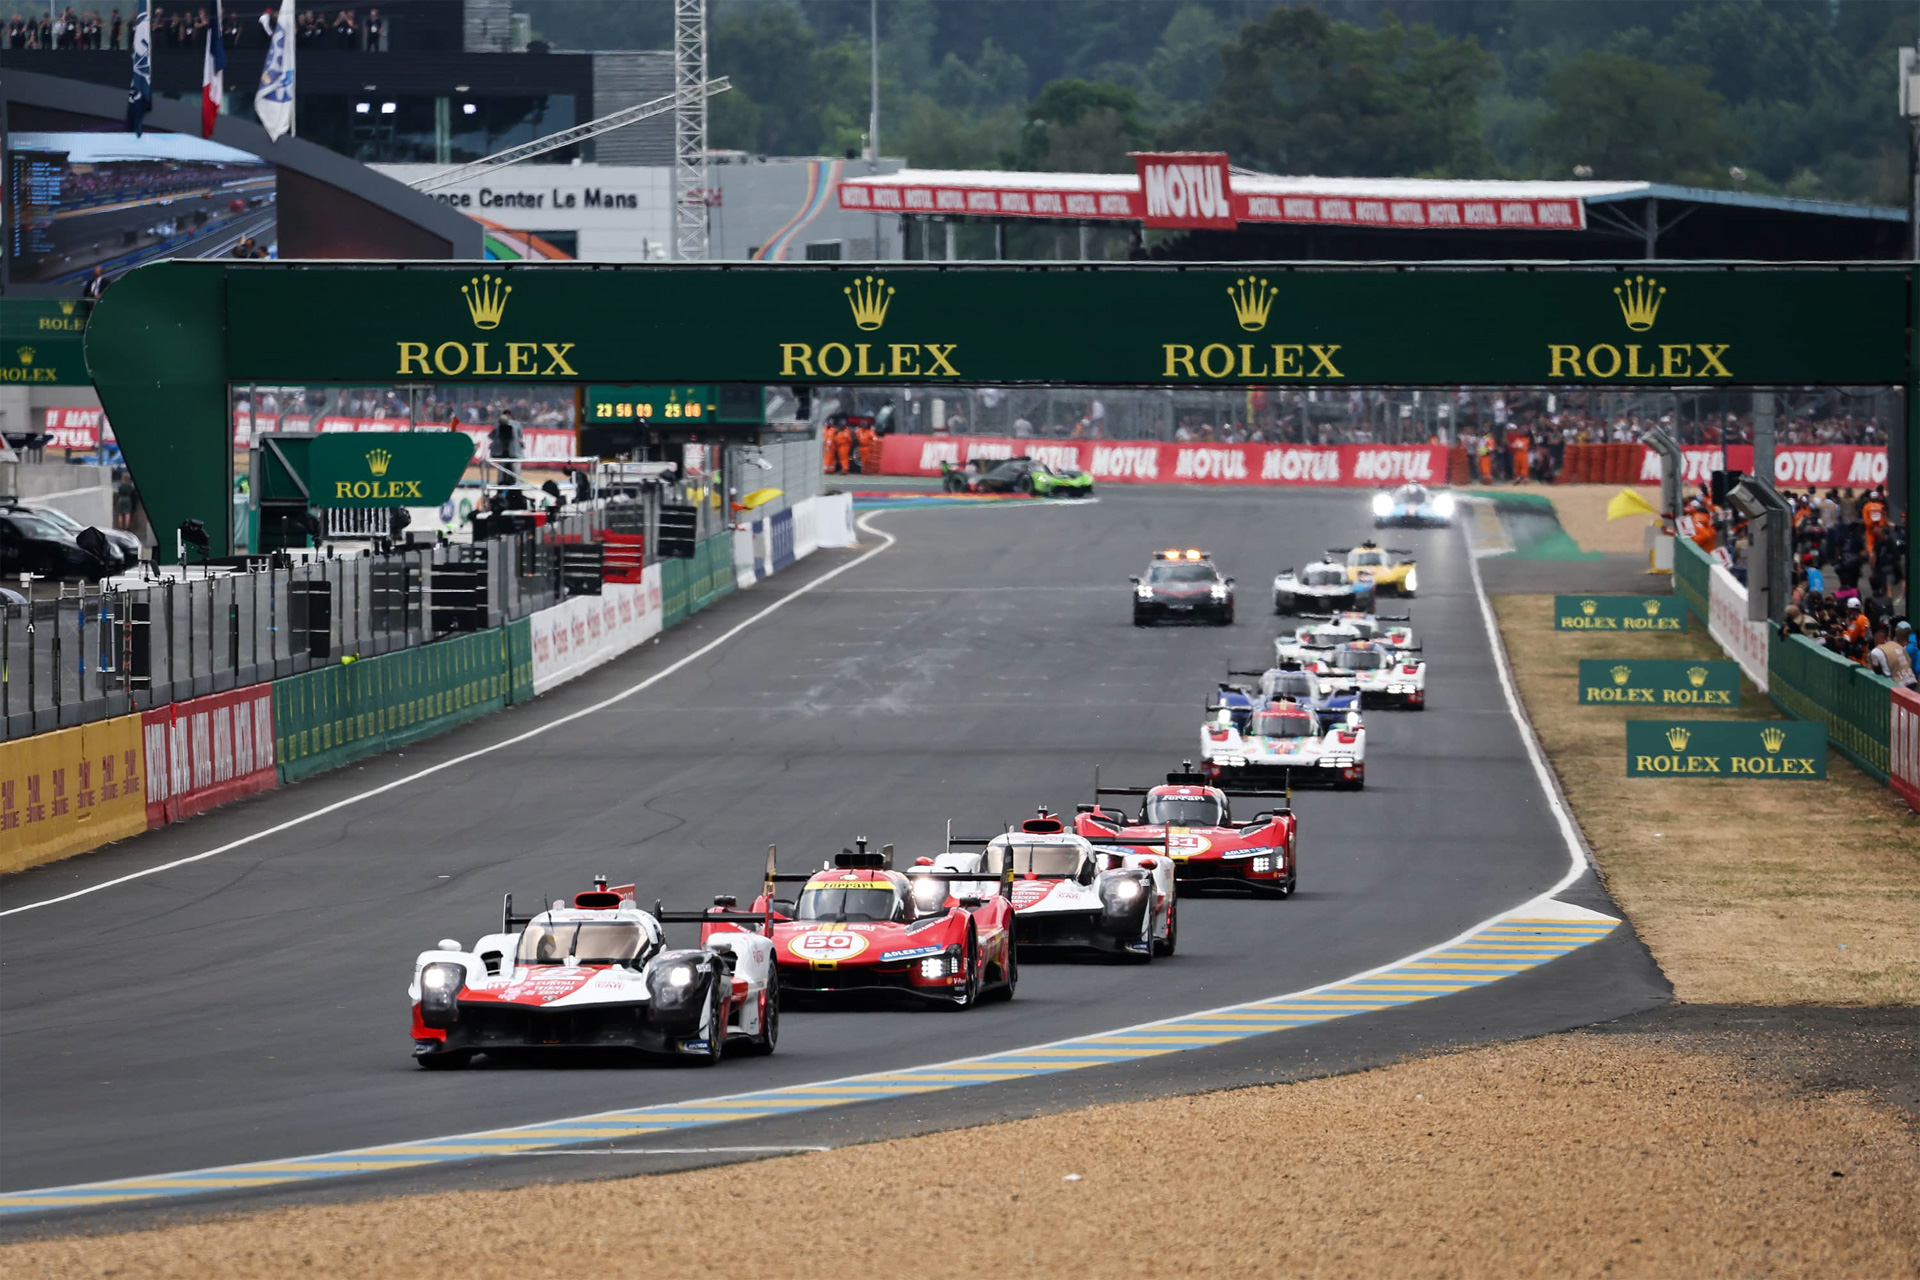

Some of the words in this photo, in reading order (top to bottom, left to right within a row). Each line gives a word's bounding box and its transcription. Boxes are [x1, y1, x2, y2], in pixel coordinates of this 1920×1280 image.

[479, 188, 544, 208] Center
[553, 188, 576, 208] Le
[584, 188, 638, 208] Mans
[1145, 164, 1229, 217] MOTUL
[397, 342, 578, 375] ROLEX
[779, 343, 960, 376] ROLEX
[1162, 344, 1344, 378] ROLEX
[1548, 343, 1734, 378] ROLEX
[596, 403, 613, 418] 23
[1091, 447, 1158, 478] MOTUL
[1175, 448, 1247, 479] MOTUL
[1261, 450, 1340, 480] MOTUL
[1354, 451, 1433, 480] MOTUL
[335, 480, 423, 499] ROLEX
[1561, 616, 1617, 629] ROLEX
[1623, 617, 1681, 630] ROLEX
[1587, 687, 1655, 702] ROLEX
[1663, 689, 1731, 704] ROLEX
[1636, 756, 1721, 773] ROLEX
[1731, 757, 1816, 774] ROLEX
[806, 936, 851, 948] 50
[884, 949, 916, 958] ADLER
